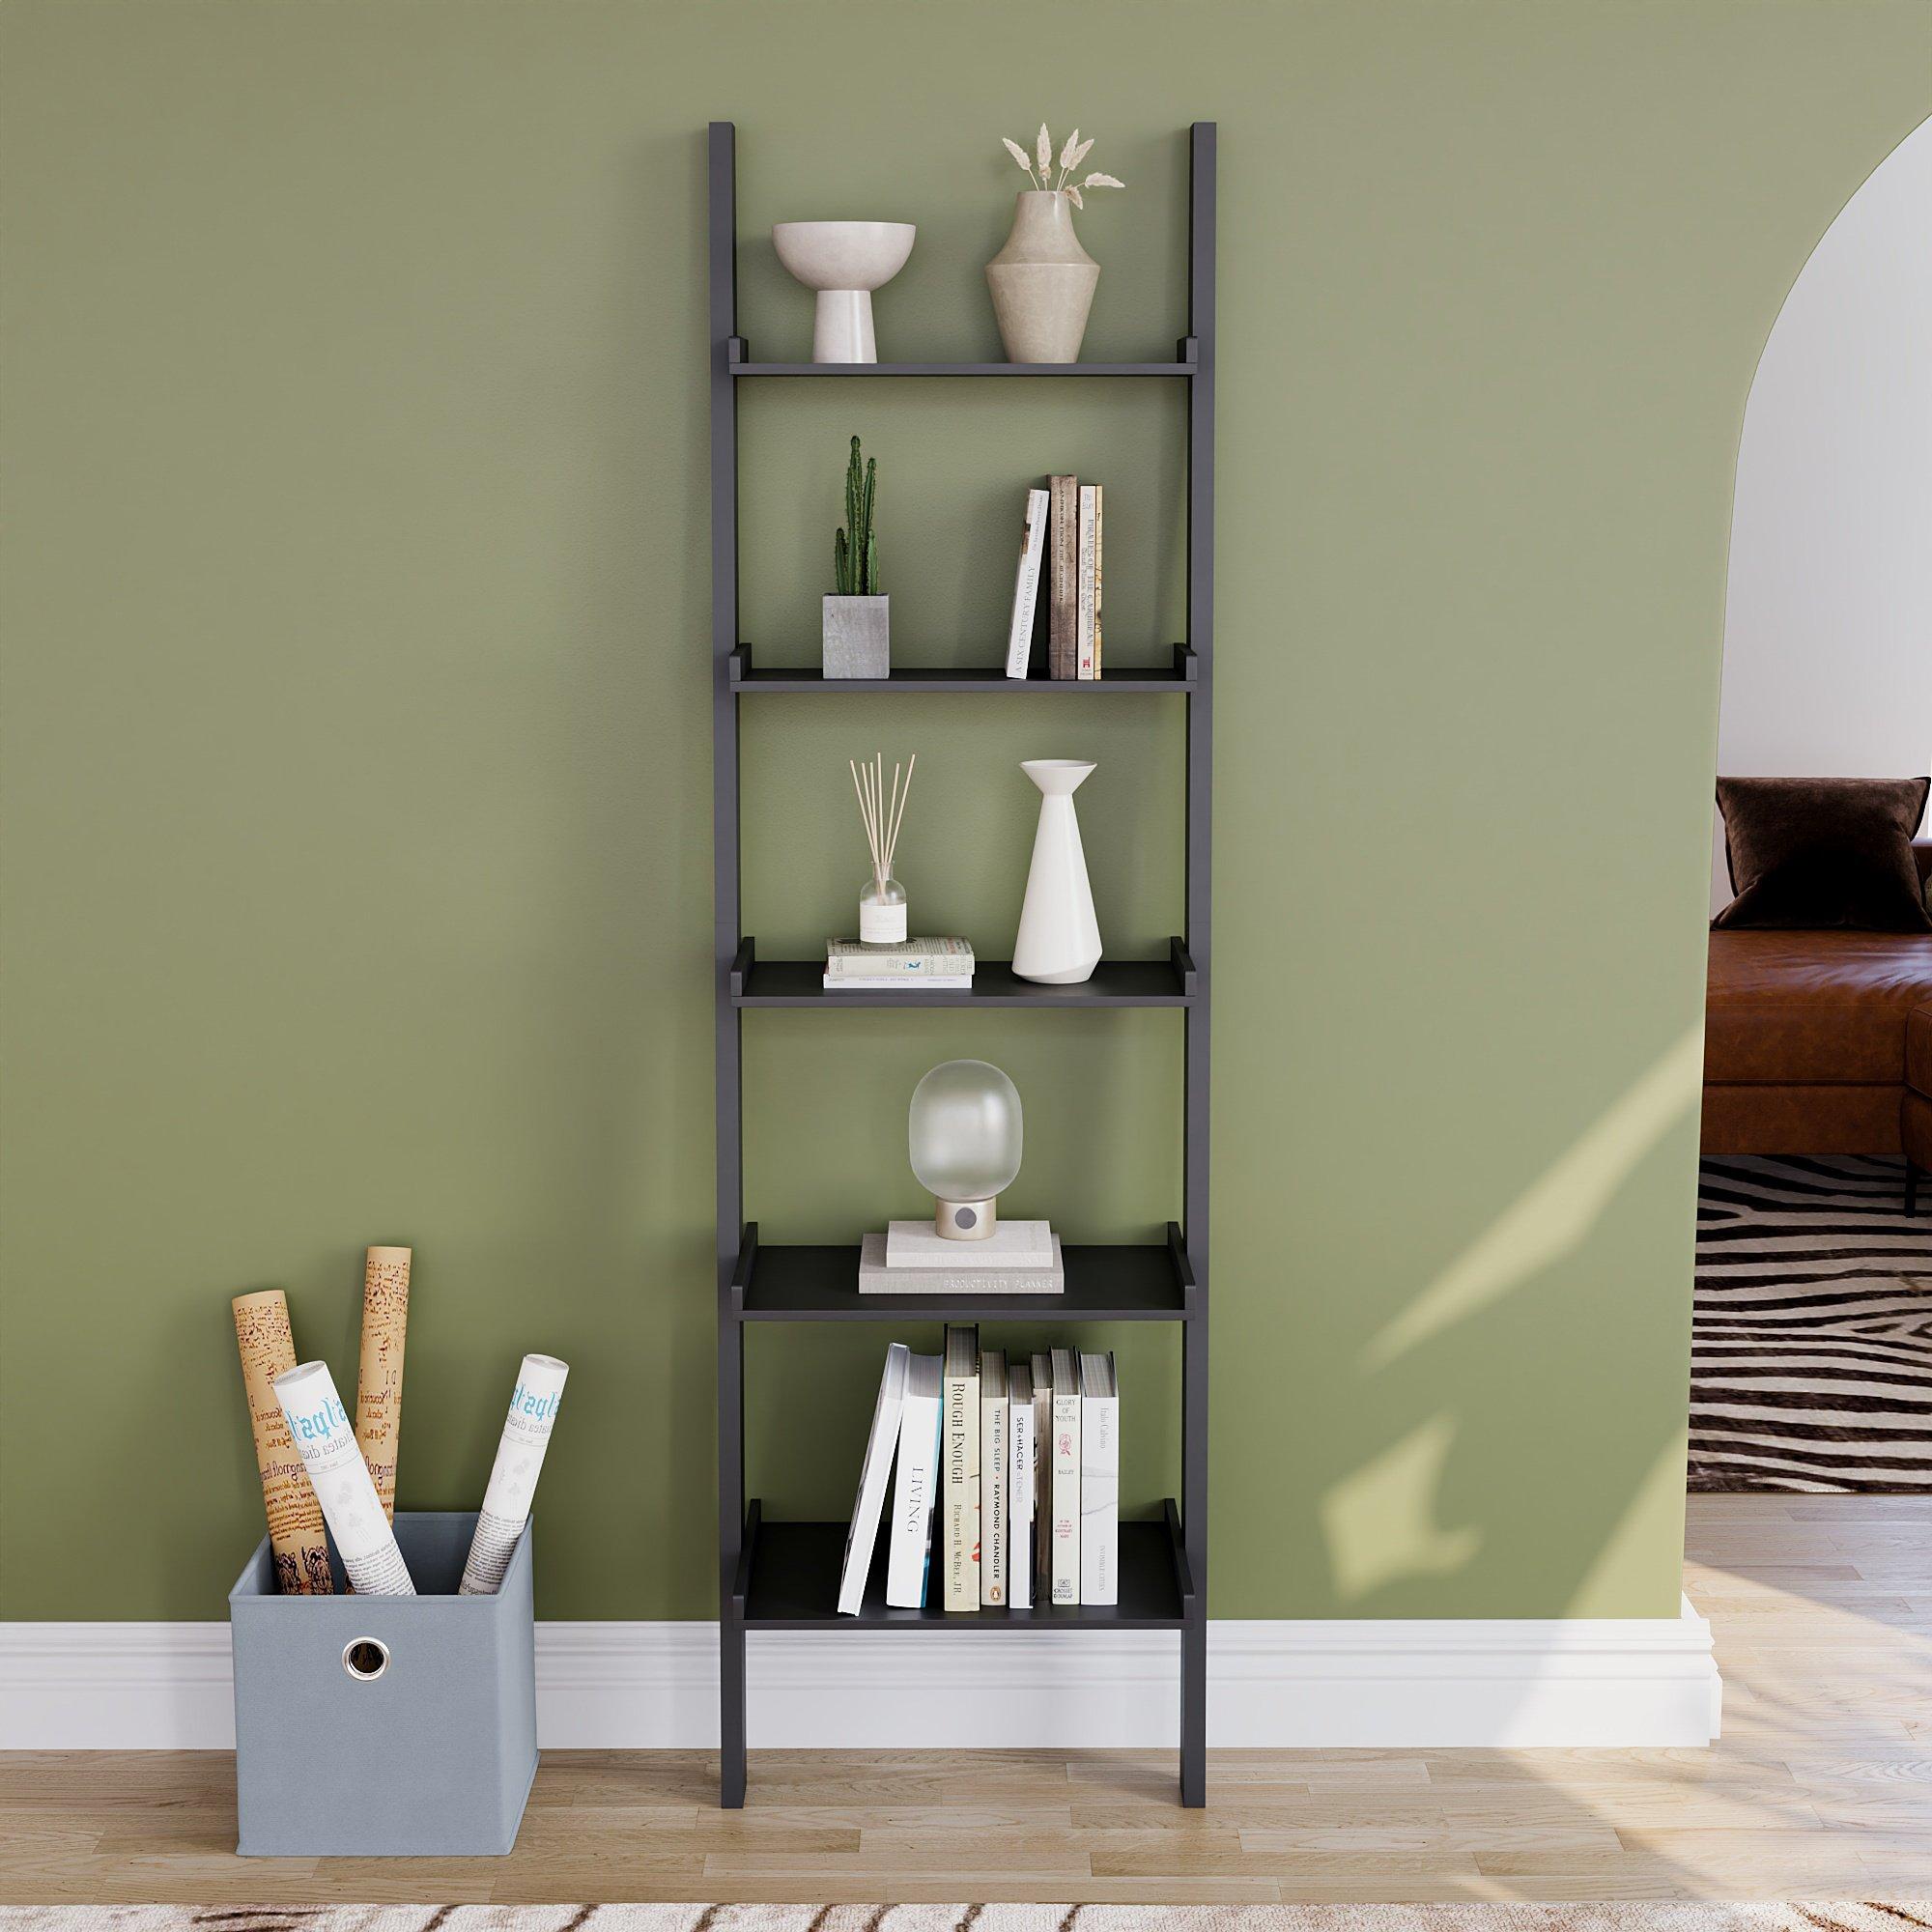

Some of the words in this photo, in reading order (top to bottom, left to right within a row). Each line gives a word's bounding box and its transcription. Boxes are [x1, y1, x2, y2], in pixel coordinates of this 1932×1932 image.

[1086, 519, 1094, 556] PIRATES
[1086, 558, 1094, 571] OF
[1024, 565, 1036, 601] FAMILY
[1086, 576, 1094, 592] THE
[1018, 604, 1031, 648] CENTURY
[1086, 594, 1094, 647] CARIBBEAN
[1015, 649, 1025, 665] SIX
[943, 1279, 1009, 1289] PRODUCTIVITY
[1015, 1279, 1054, 1289] PLANNER
[952, 1383, 966, 1427] ROUGH
[1055, 1414, 1076, 1423] YOUTH
[1100, 1407, 1109, 1423] Italo
[952, 1433, 965, 1484] ENOUGH
[907, 1466, 923, 1534] LIVING
[953, 1504, 962, 1538] RICHARD
